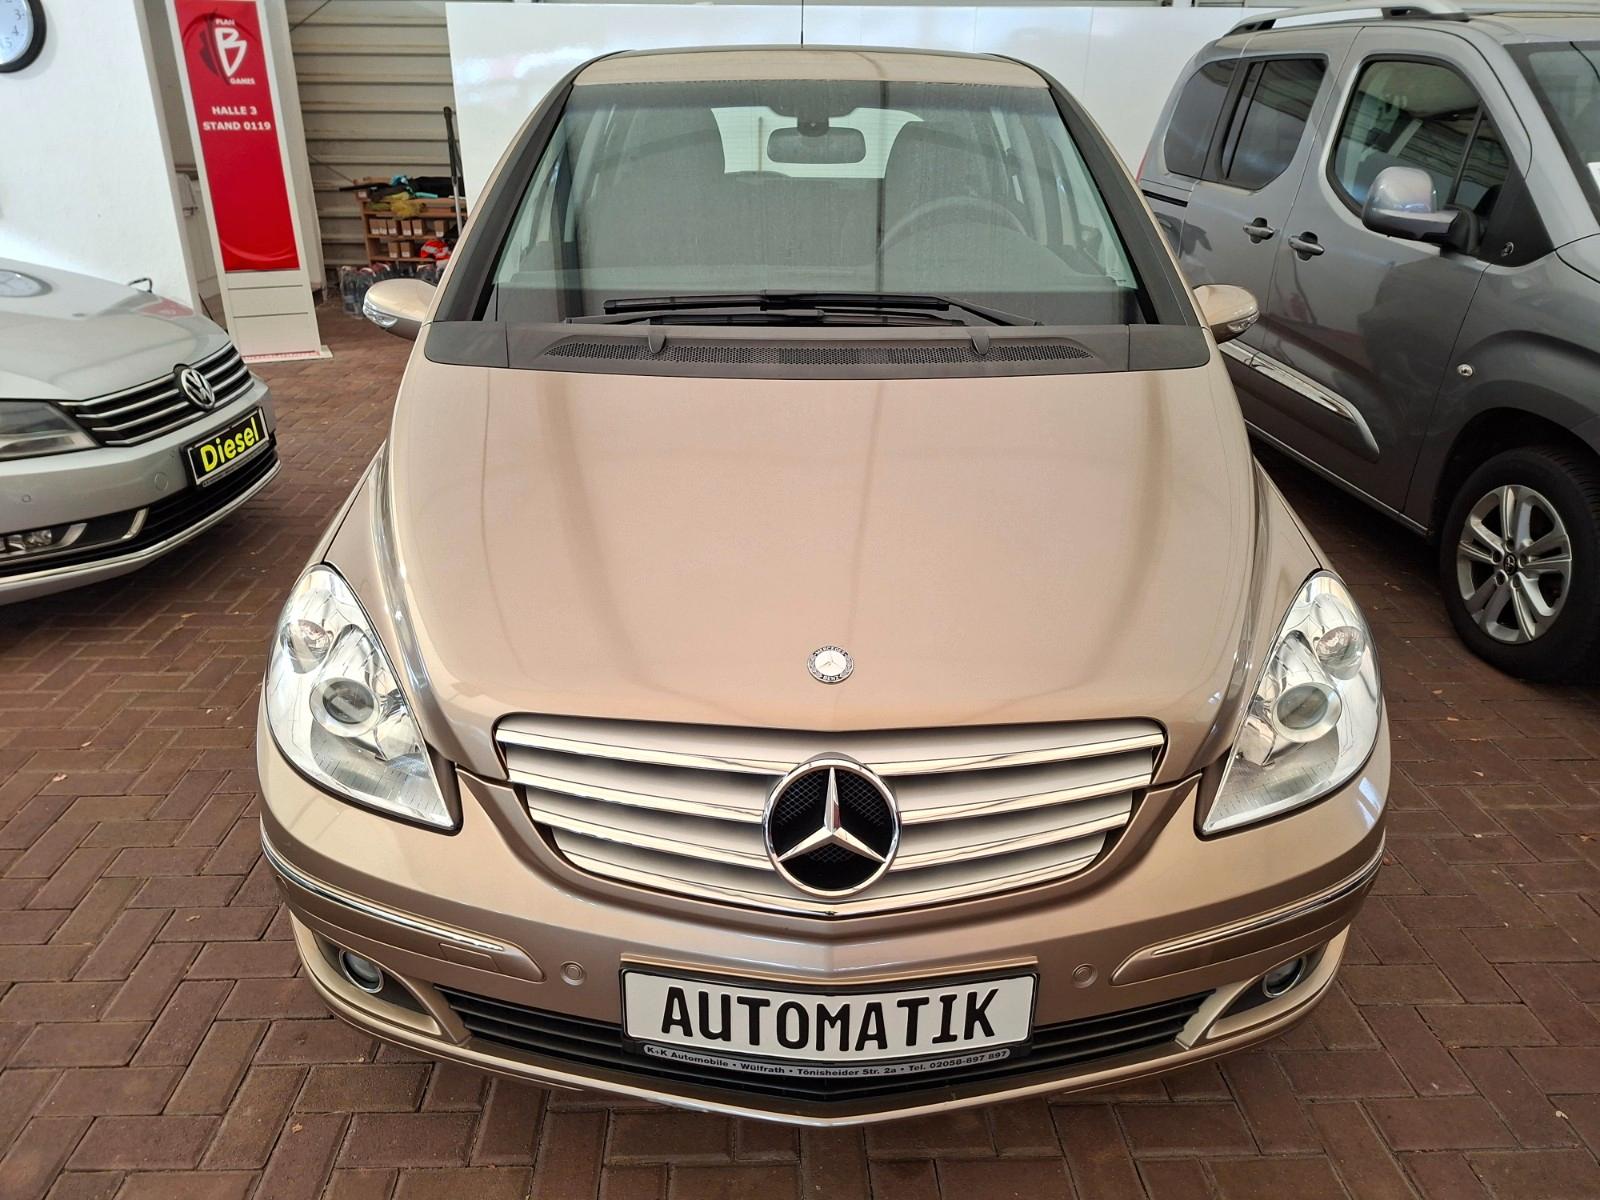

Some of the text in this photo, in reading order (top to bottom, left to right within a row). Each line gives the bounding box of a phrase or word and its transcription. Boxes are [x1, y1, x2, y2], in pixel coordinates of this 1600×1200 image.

[14, 9, 22, 20] 3
[214, 27, 248, 78] B
[202, 121, 272, 131] STAND 0119
[211, 105, 258, 116] HALLE 3
[200, 416, 259, 472] Diesel
[661, 986, 999, 1051] AUTOMATIK
[647, 1045, 1007, 1077] K+K Automobile Wülfrath Tönisheider Str. 2a Tel. 02058-897 897
